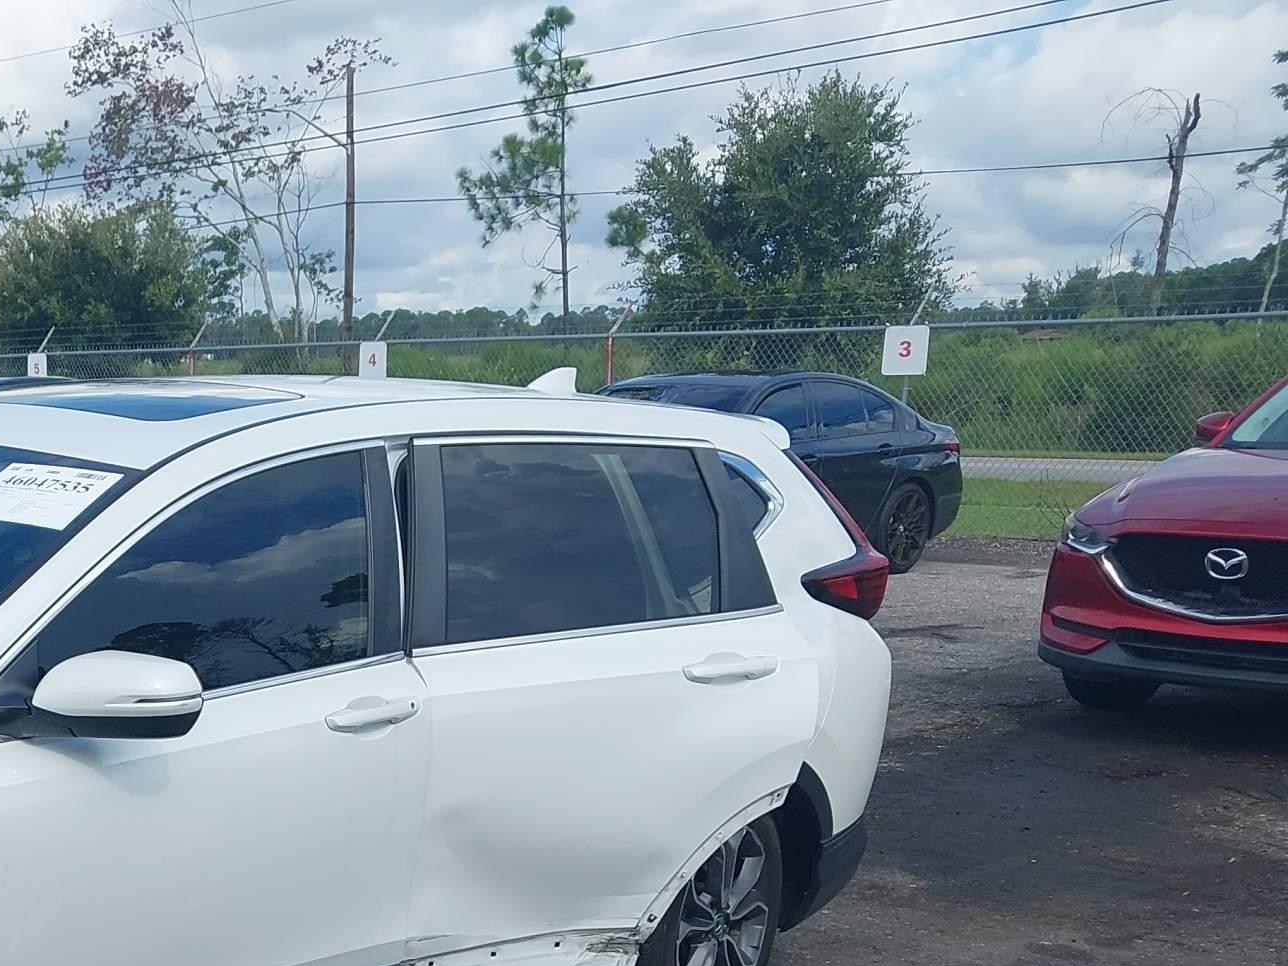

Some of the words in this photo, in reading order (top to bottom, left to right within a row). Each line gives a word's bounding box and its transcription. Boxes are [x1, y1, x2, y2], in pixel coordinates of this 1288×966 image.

[898, 340, 912, 358] 3
[368, 353, 377, 367] 4
[34, 363, 40, 374] 5
[2, 474, 96, 494] 46047535
